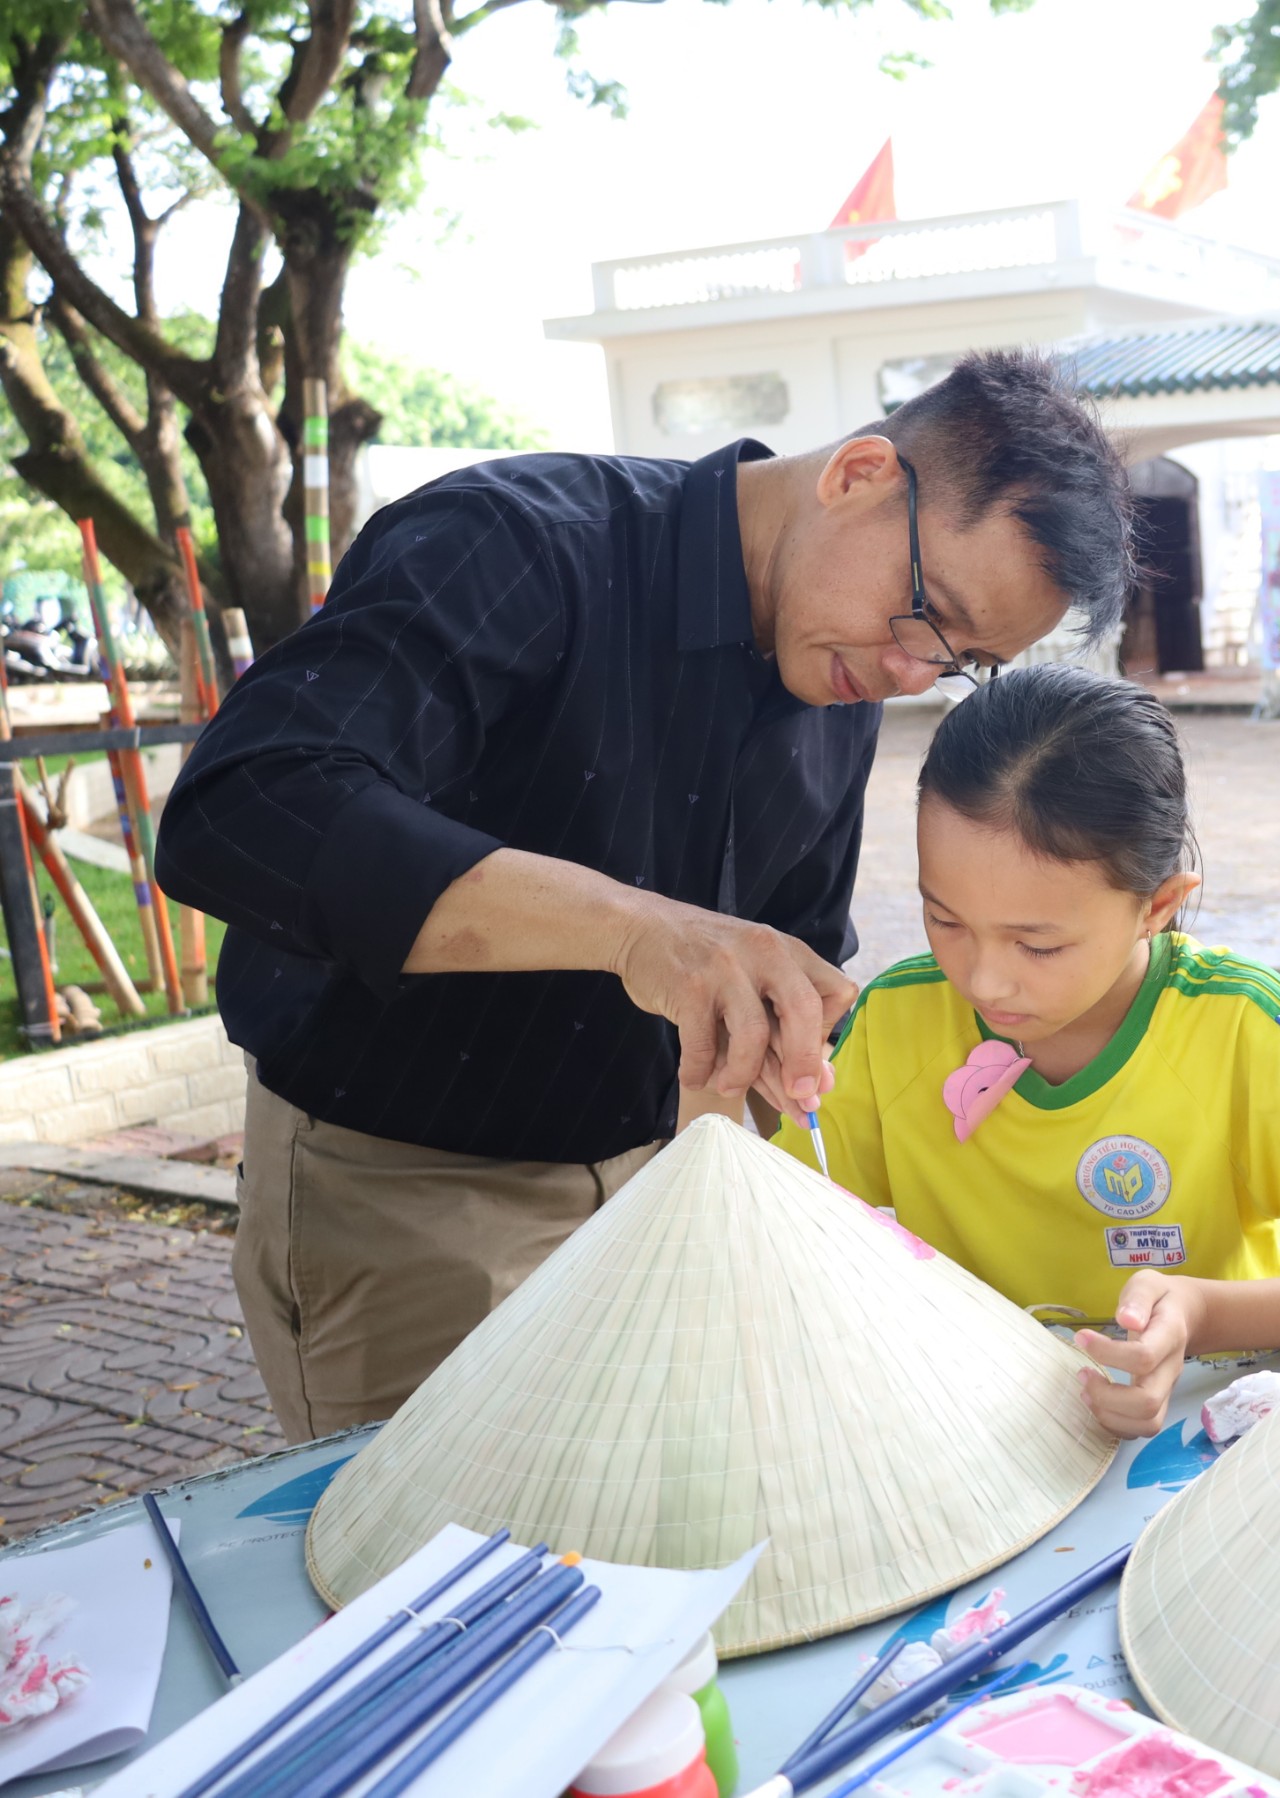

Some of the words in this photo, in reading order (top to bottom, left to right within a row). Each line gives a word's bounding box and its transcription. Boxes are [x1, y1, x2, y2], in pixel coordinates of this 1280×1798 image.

[1117, 1208, 1135, 1216] CAO
[1129, 1251, 1151, 1263] NHƯ
[1166, 1251, 1183, 1263] 4/3
